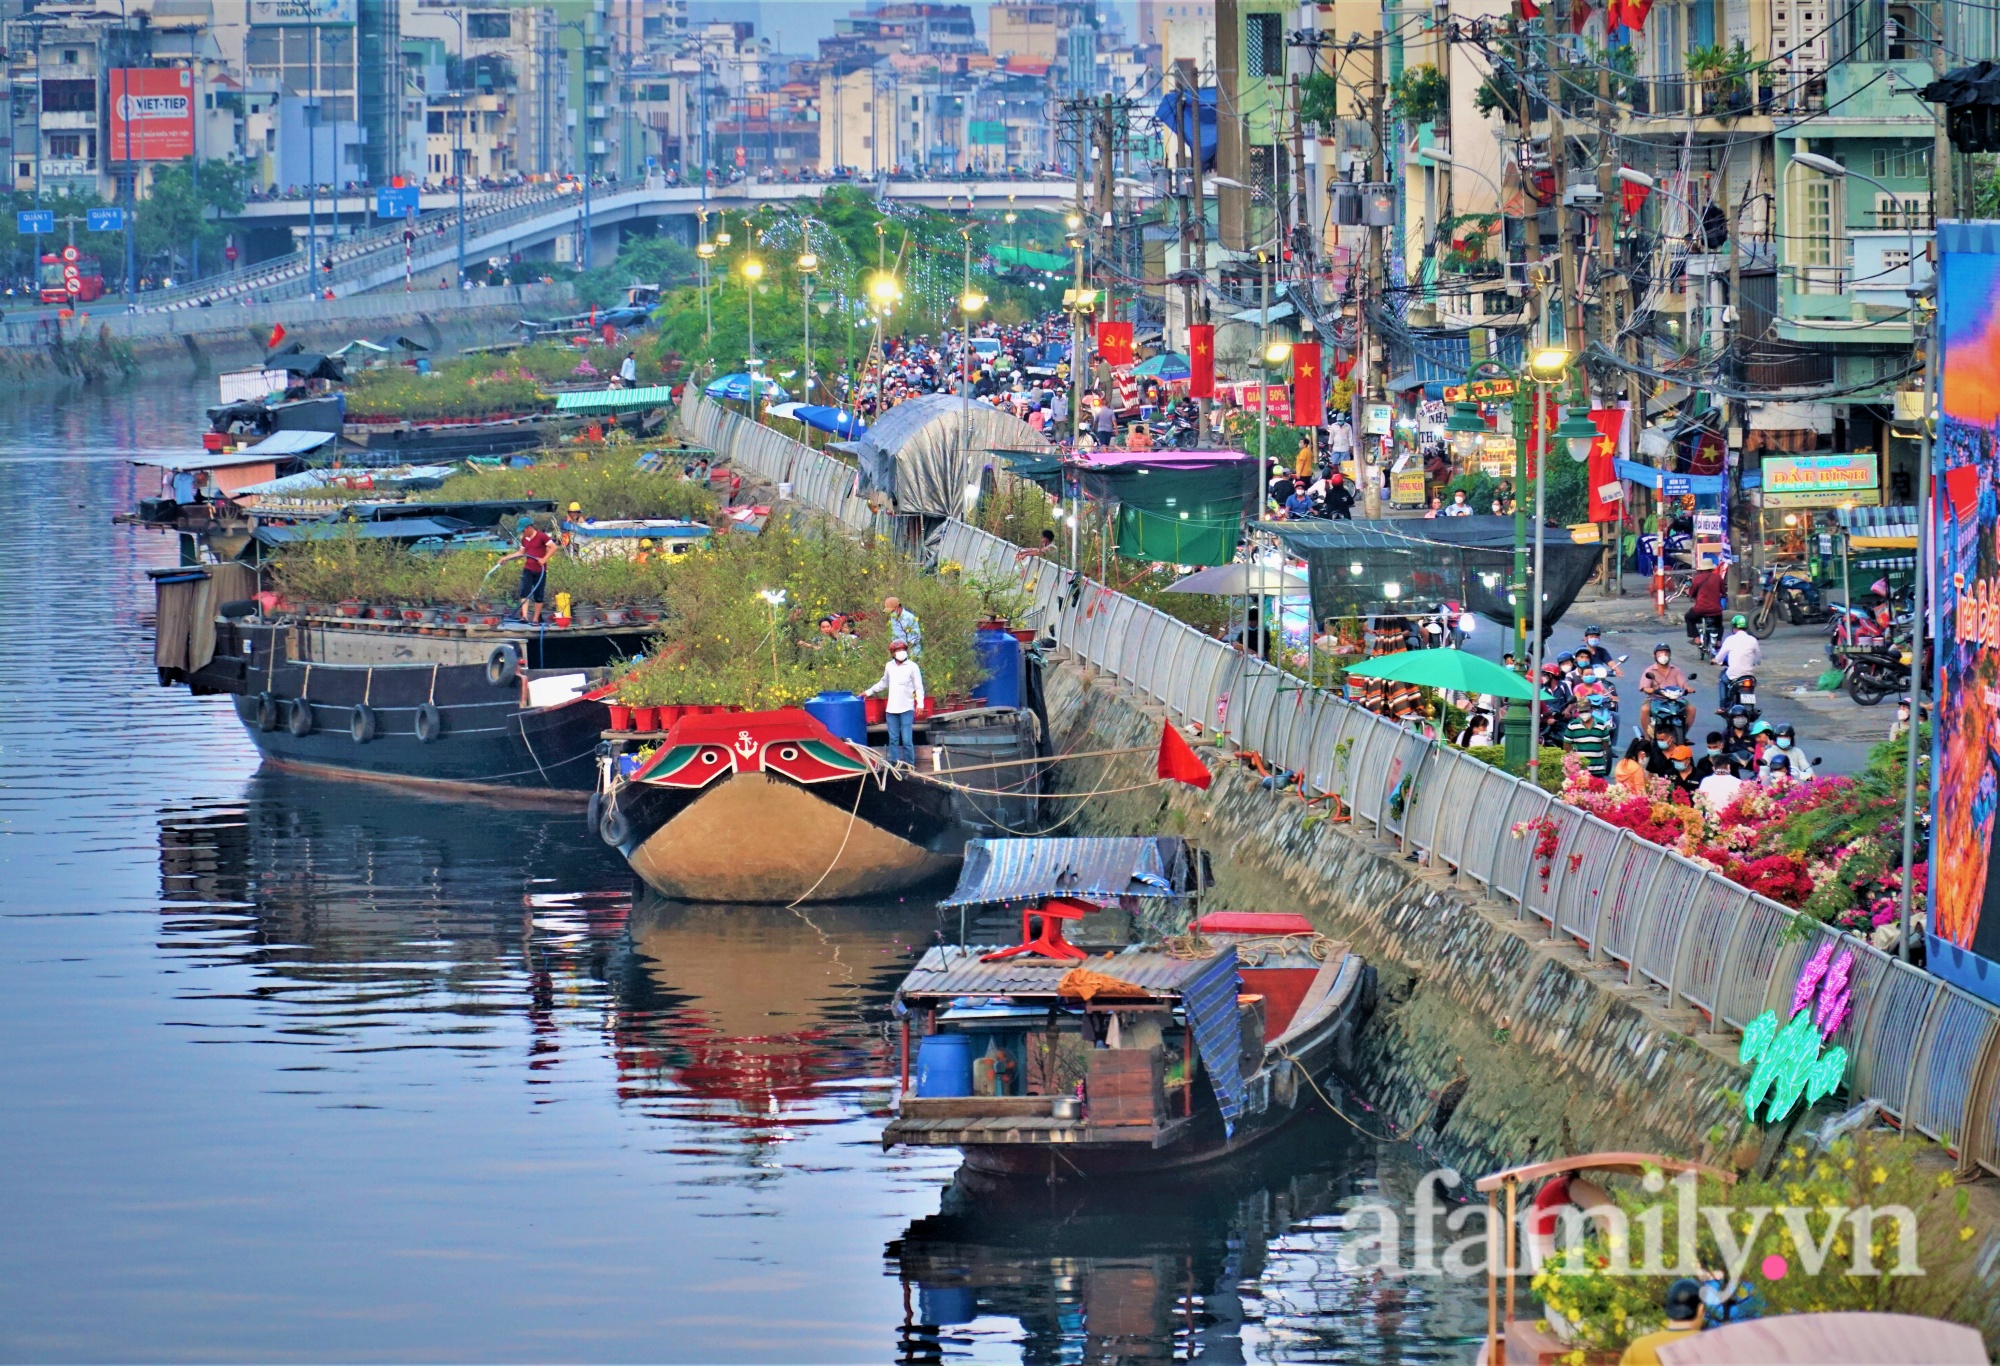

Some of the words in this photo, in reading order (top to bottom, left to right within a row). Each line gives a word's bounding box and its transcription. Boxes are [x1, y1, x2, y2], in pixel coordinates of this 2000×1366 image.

[1269, 390, 1286, 401] 50%
[1815, 458, 1852, 468] QUAY
[1818, 467, 1867, 482] BÌNH
